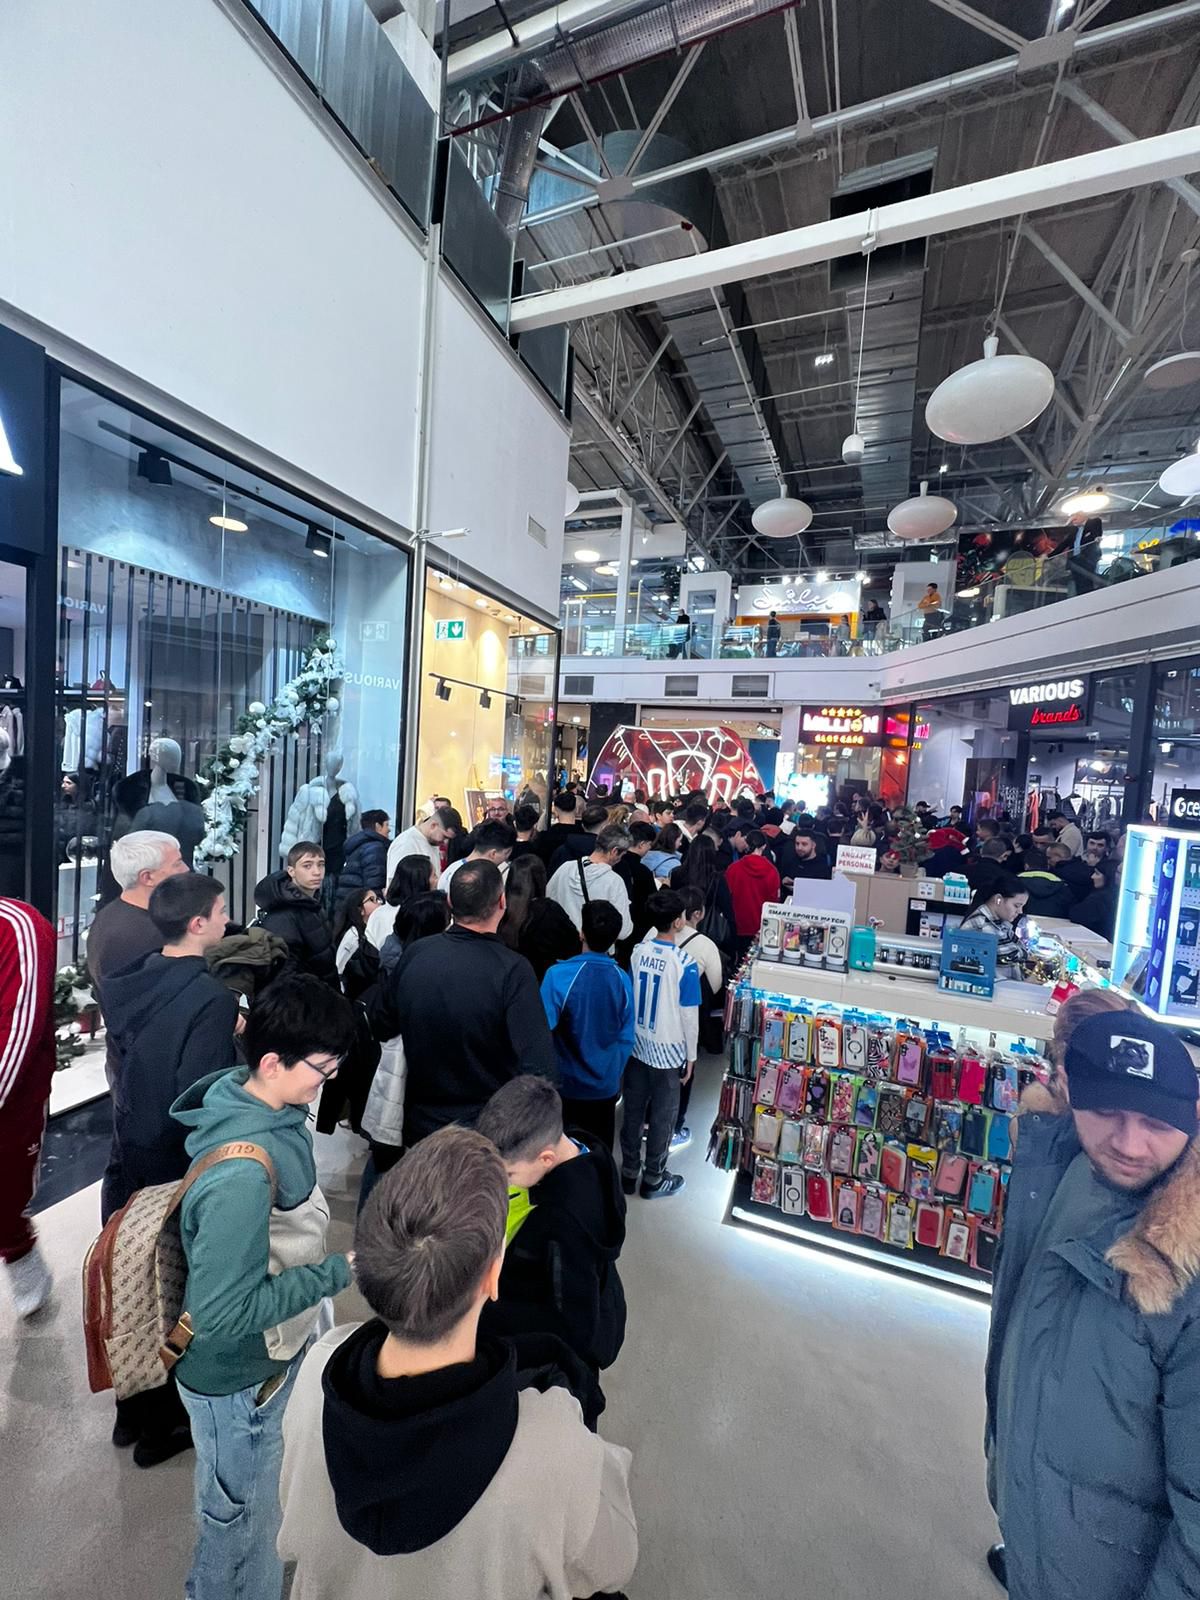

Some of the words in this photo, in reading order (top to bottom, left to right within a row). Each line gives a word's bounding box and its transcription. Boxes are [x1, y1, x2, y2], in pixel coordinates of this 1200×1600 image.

[1010, 679, 1084, 705] VARIOUS
[1031, 704, 1079, 725] brands
[1174, 797, 1200, 817] Oce
[838, 860, 873, 869] PERSONAL
[768, 909, 791, 917] SMART
[793, 911, 819, 920] SPORTS
[637, 971, 661, 1030] 11
